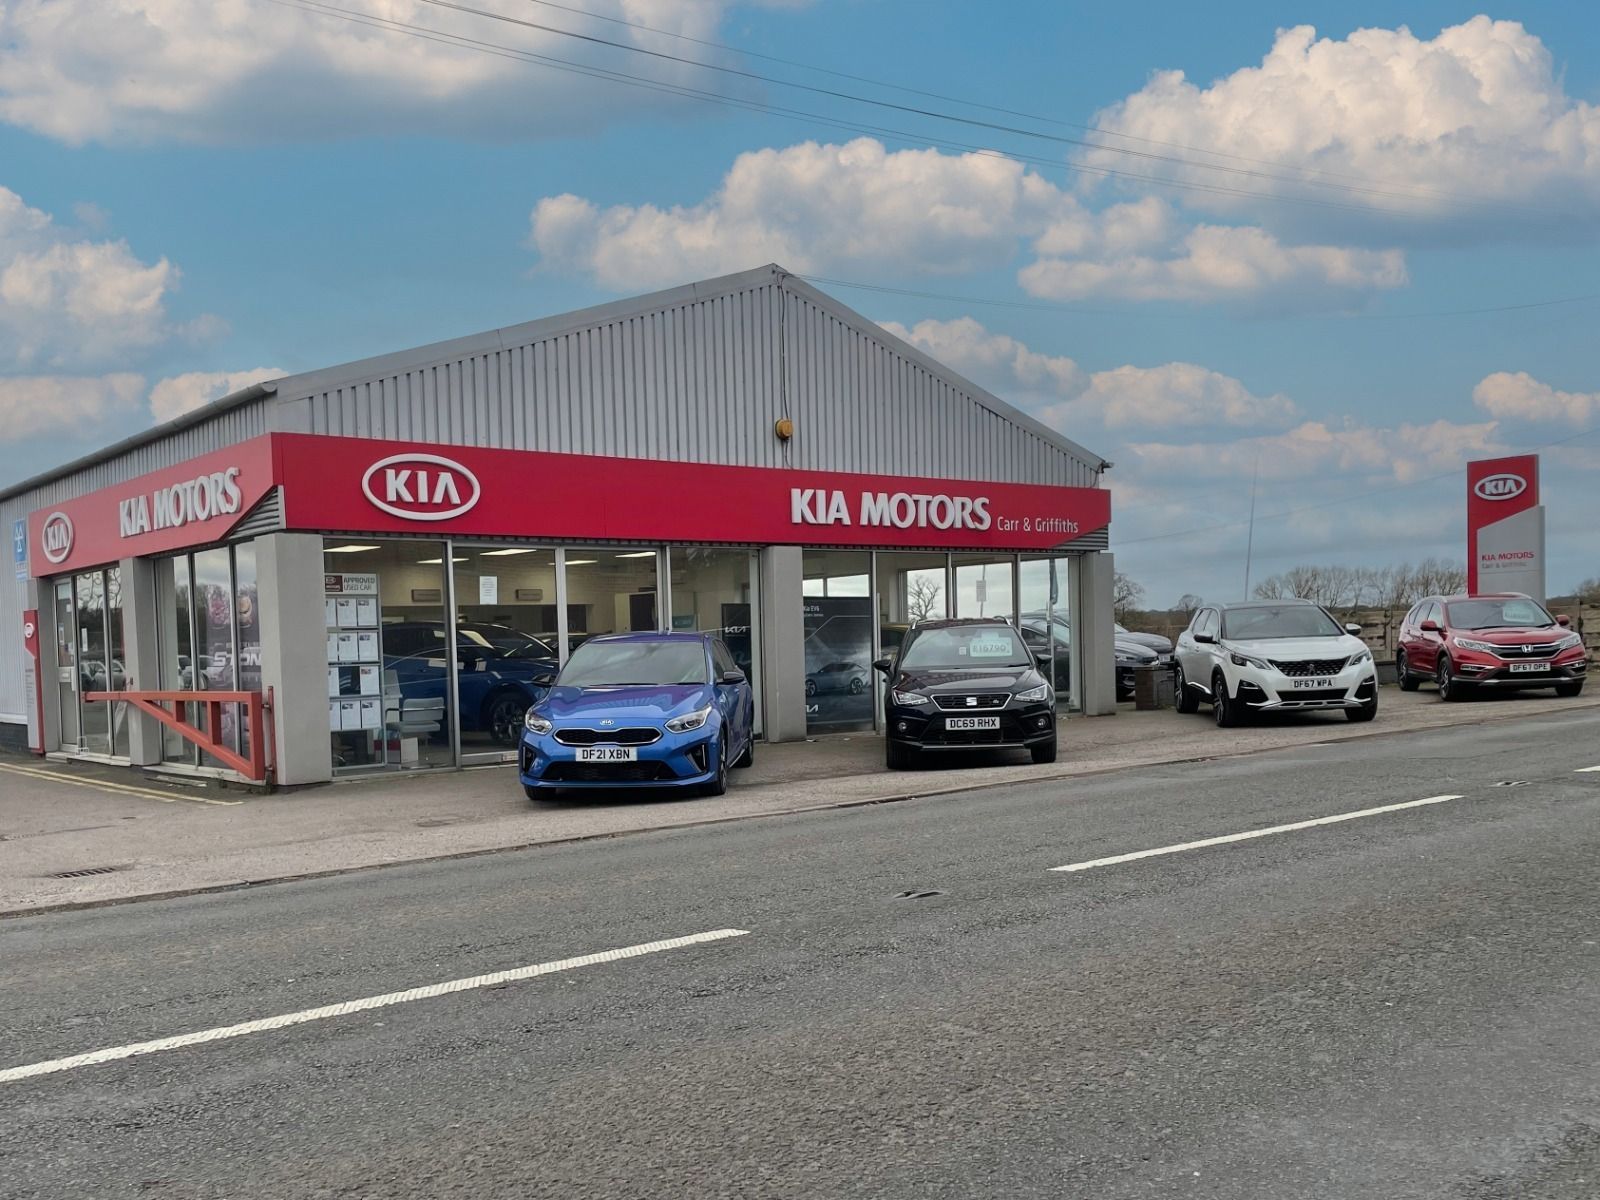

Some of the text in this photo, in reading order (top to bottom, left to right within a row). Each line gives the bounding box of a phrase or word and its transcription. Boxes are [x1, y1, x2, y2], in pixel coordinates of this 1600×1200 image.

[385, 468, 461, 505] KIA
[1484, 479, 1517, 495] KIA
[120, 466, 242, 538] KIA MOTORS
[790, 487, 992, 531] KIA MOTORS
[997, 516, 1079, 534] Carr & Griffiths
[47, 523, 68, 551] KIA
[1481, 551, 1535, 561] KIA MOTORS
[1294, 679, 1333, 688] DF67 WPA
[950, 718, 997, 729] DC69 RHX
[582, 749, 630, 760] DF21 XBN
